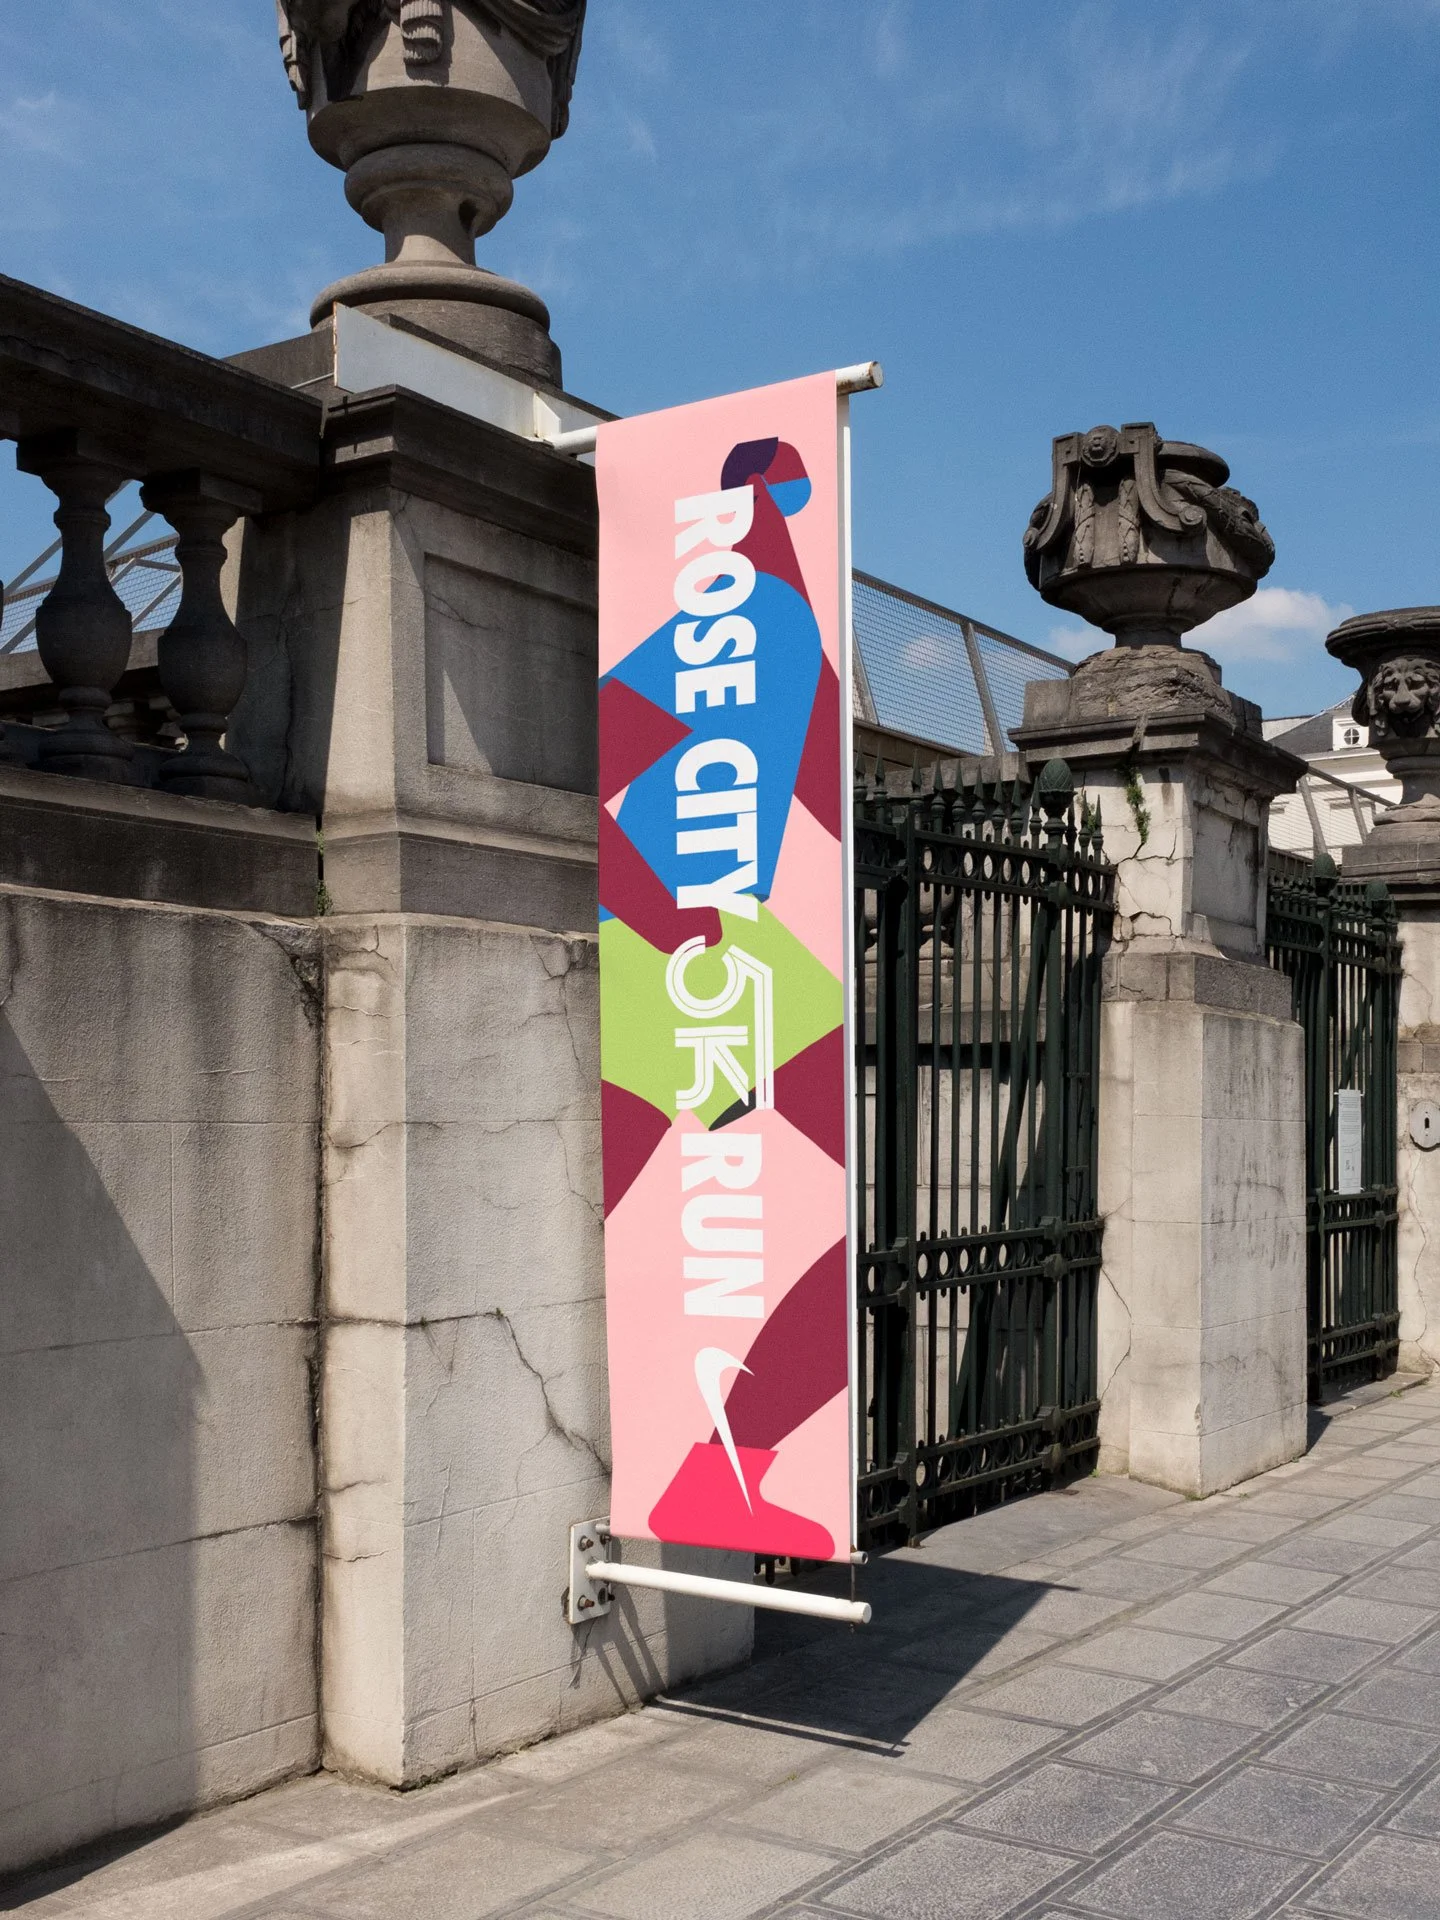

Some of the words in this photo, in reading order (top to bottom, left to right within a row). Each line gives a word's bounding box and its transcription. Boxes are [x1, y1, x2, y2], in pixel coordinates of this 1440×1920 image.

[674, 483, 757, 714] ROSE
[674, 738, 758, 922] CITY
[665, 935, 774, 1111] 5K
[681, 1133, 765, 1319] RUN
